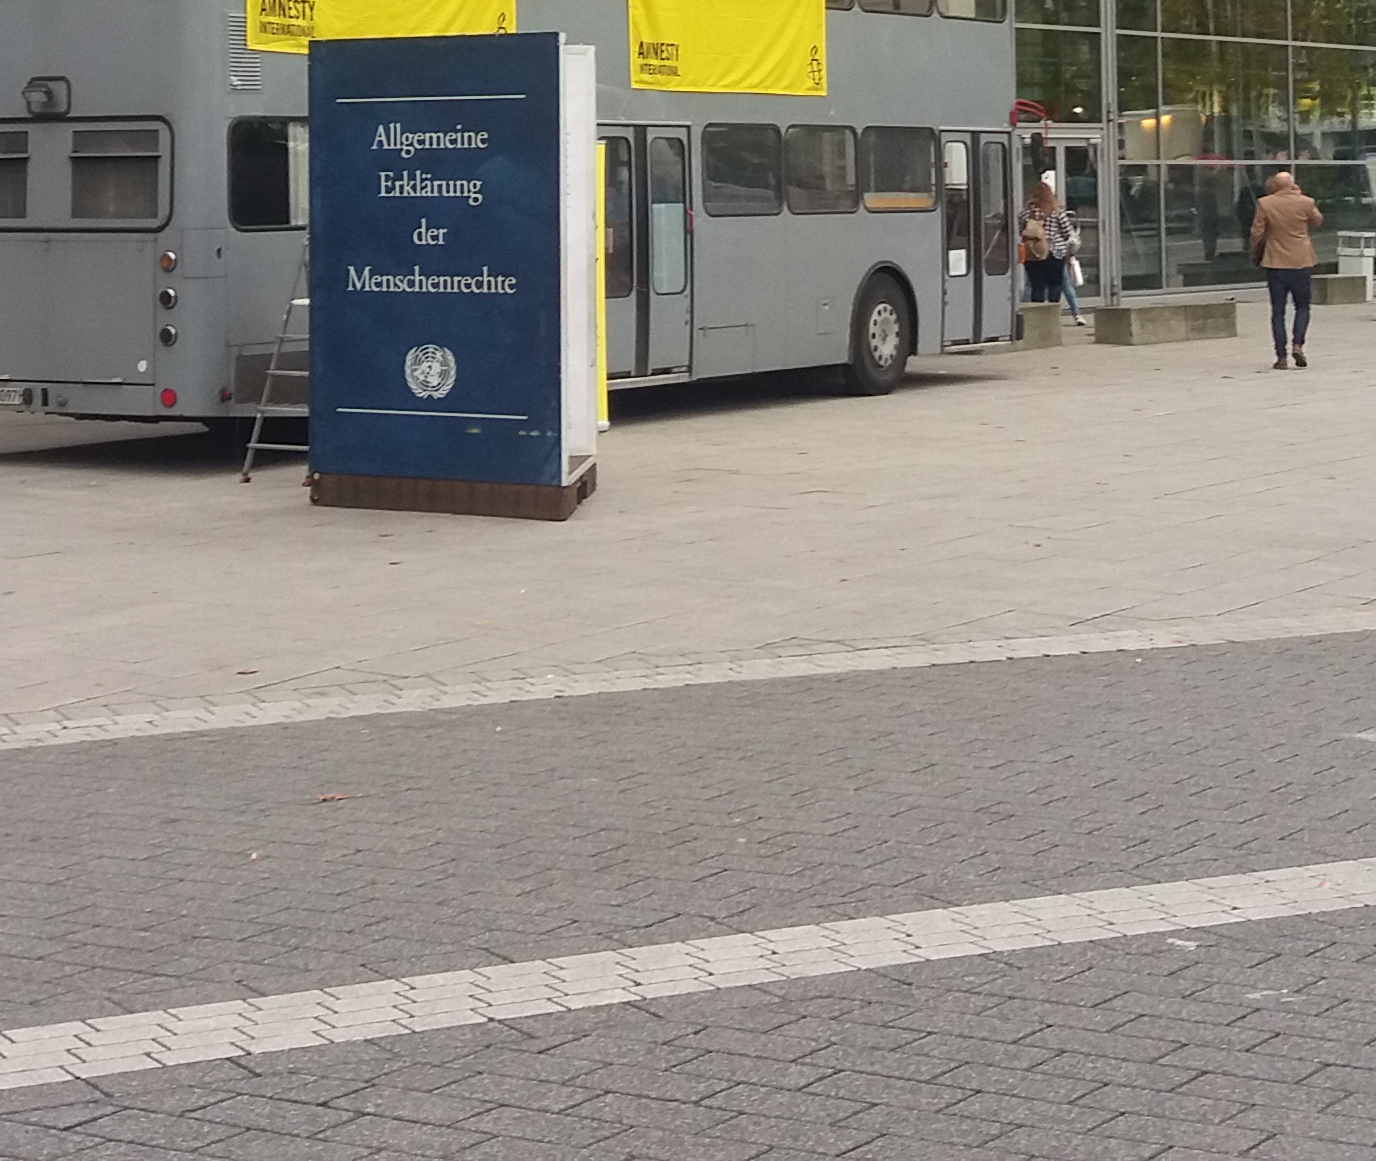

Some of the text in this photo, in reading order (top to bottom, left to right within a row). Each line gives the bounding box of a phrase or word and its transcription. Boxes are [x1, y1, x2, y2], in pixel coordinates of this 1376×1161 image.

[371, 122, 489, 159] Allgemeine
[378, 170, 483, 206] Erklärung
[412, 218, 448, 245] der
[346, 265, 517, 294] Menschenrechte
